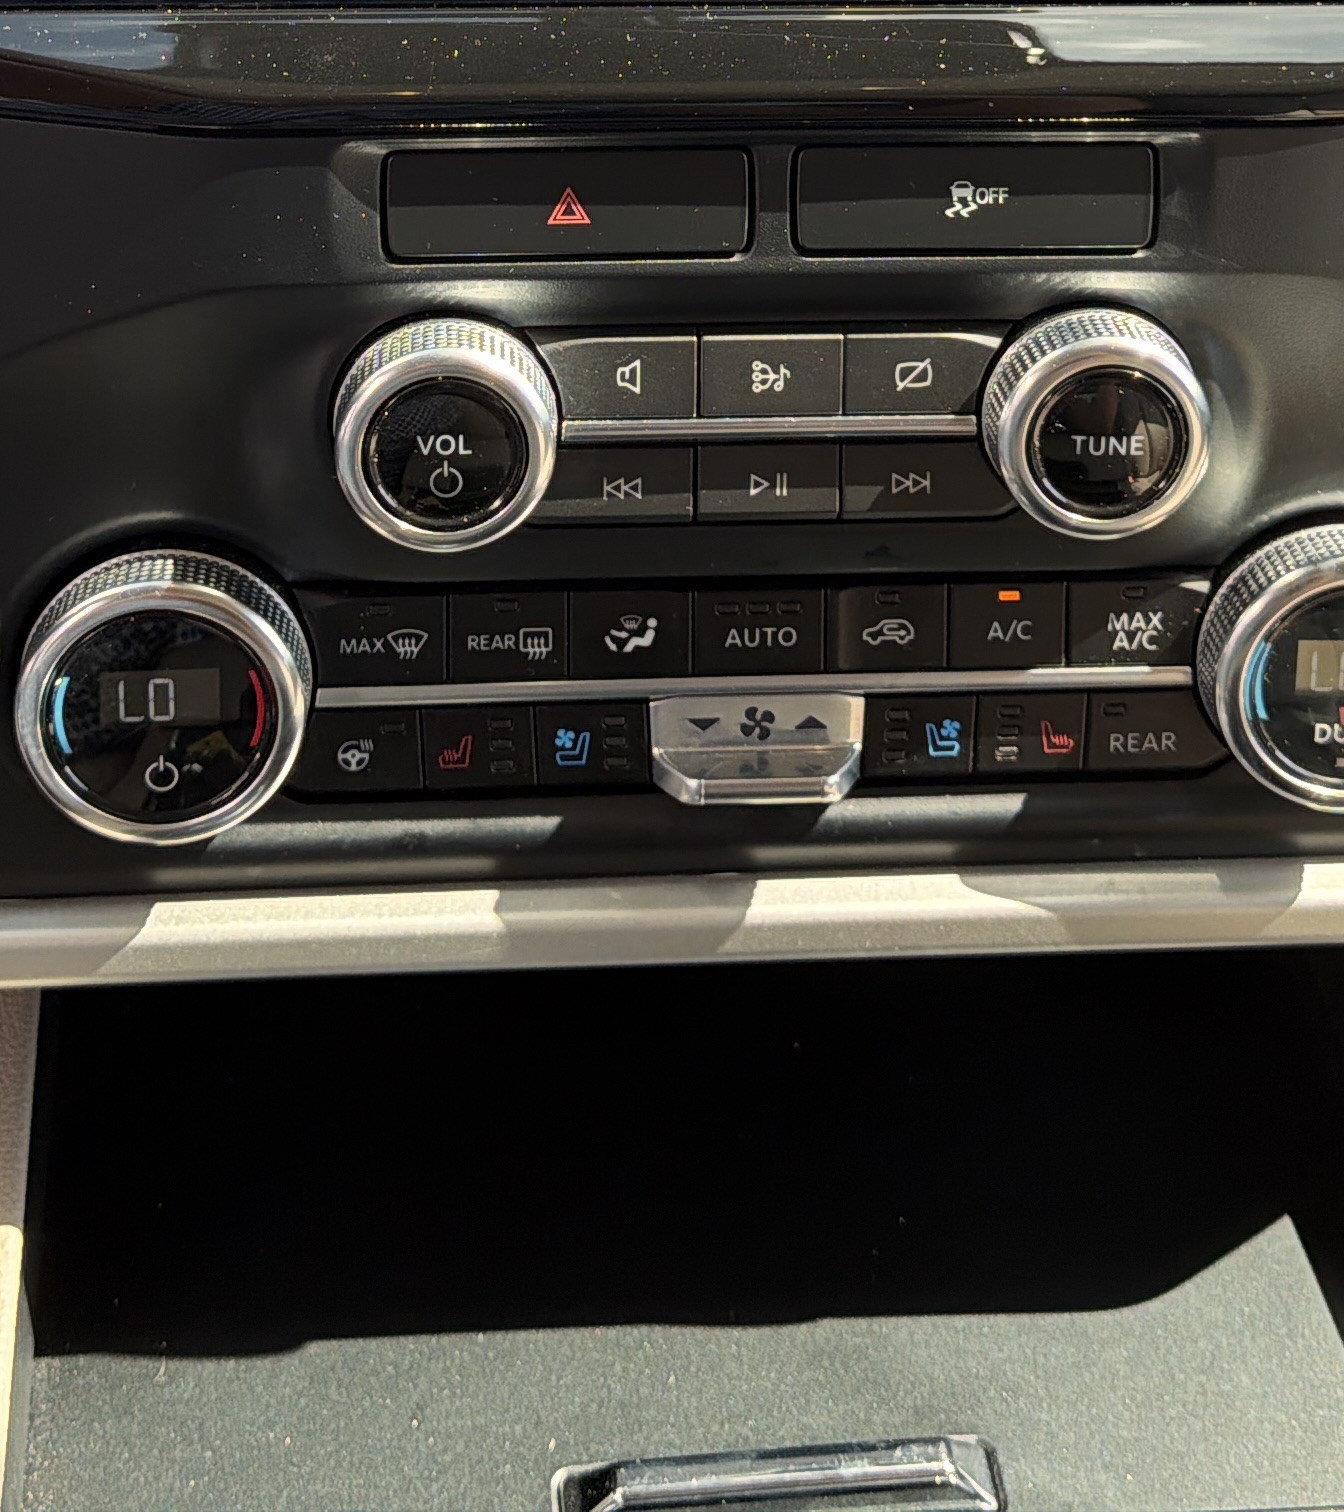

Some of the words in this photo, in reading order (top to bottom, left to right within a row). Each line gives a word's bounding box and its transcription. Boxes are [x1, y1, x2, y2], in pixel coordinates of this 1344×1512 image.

[975, 187, 1009, 205] OFF
[416, 434, 473, 456] VOL
[1071, 434, 1146, 458] TUNE
[987, 619, 1032, 642] A/C
[1107, 611, 1164, 633] MAX
[339, 637, 386, 654] MAX
[467, 633, 516, 651] REAR
[724, 626, 798, 648] AUTO
[1111, 629, 1160, 652] A/C
[1109, 731, 1176, 753] REAR
